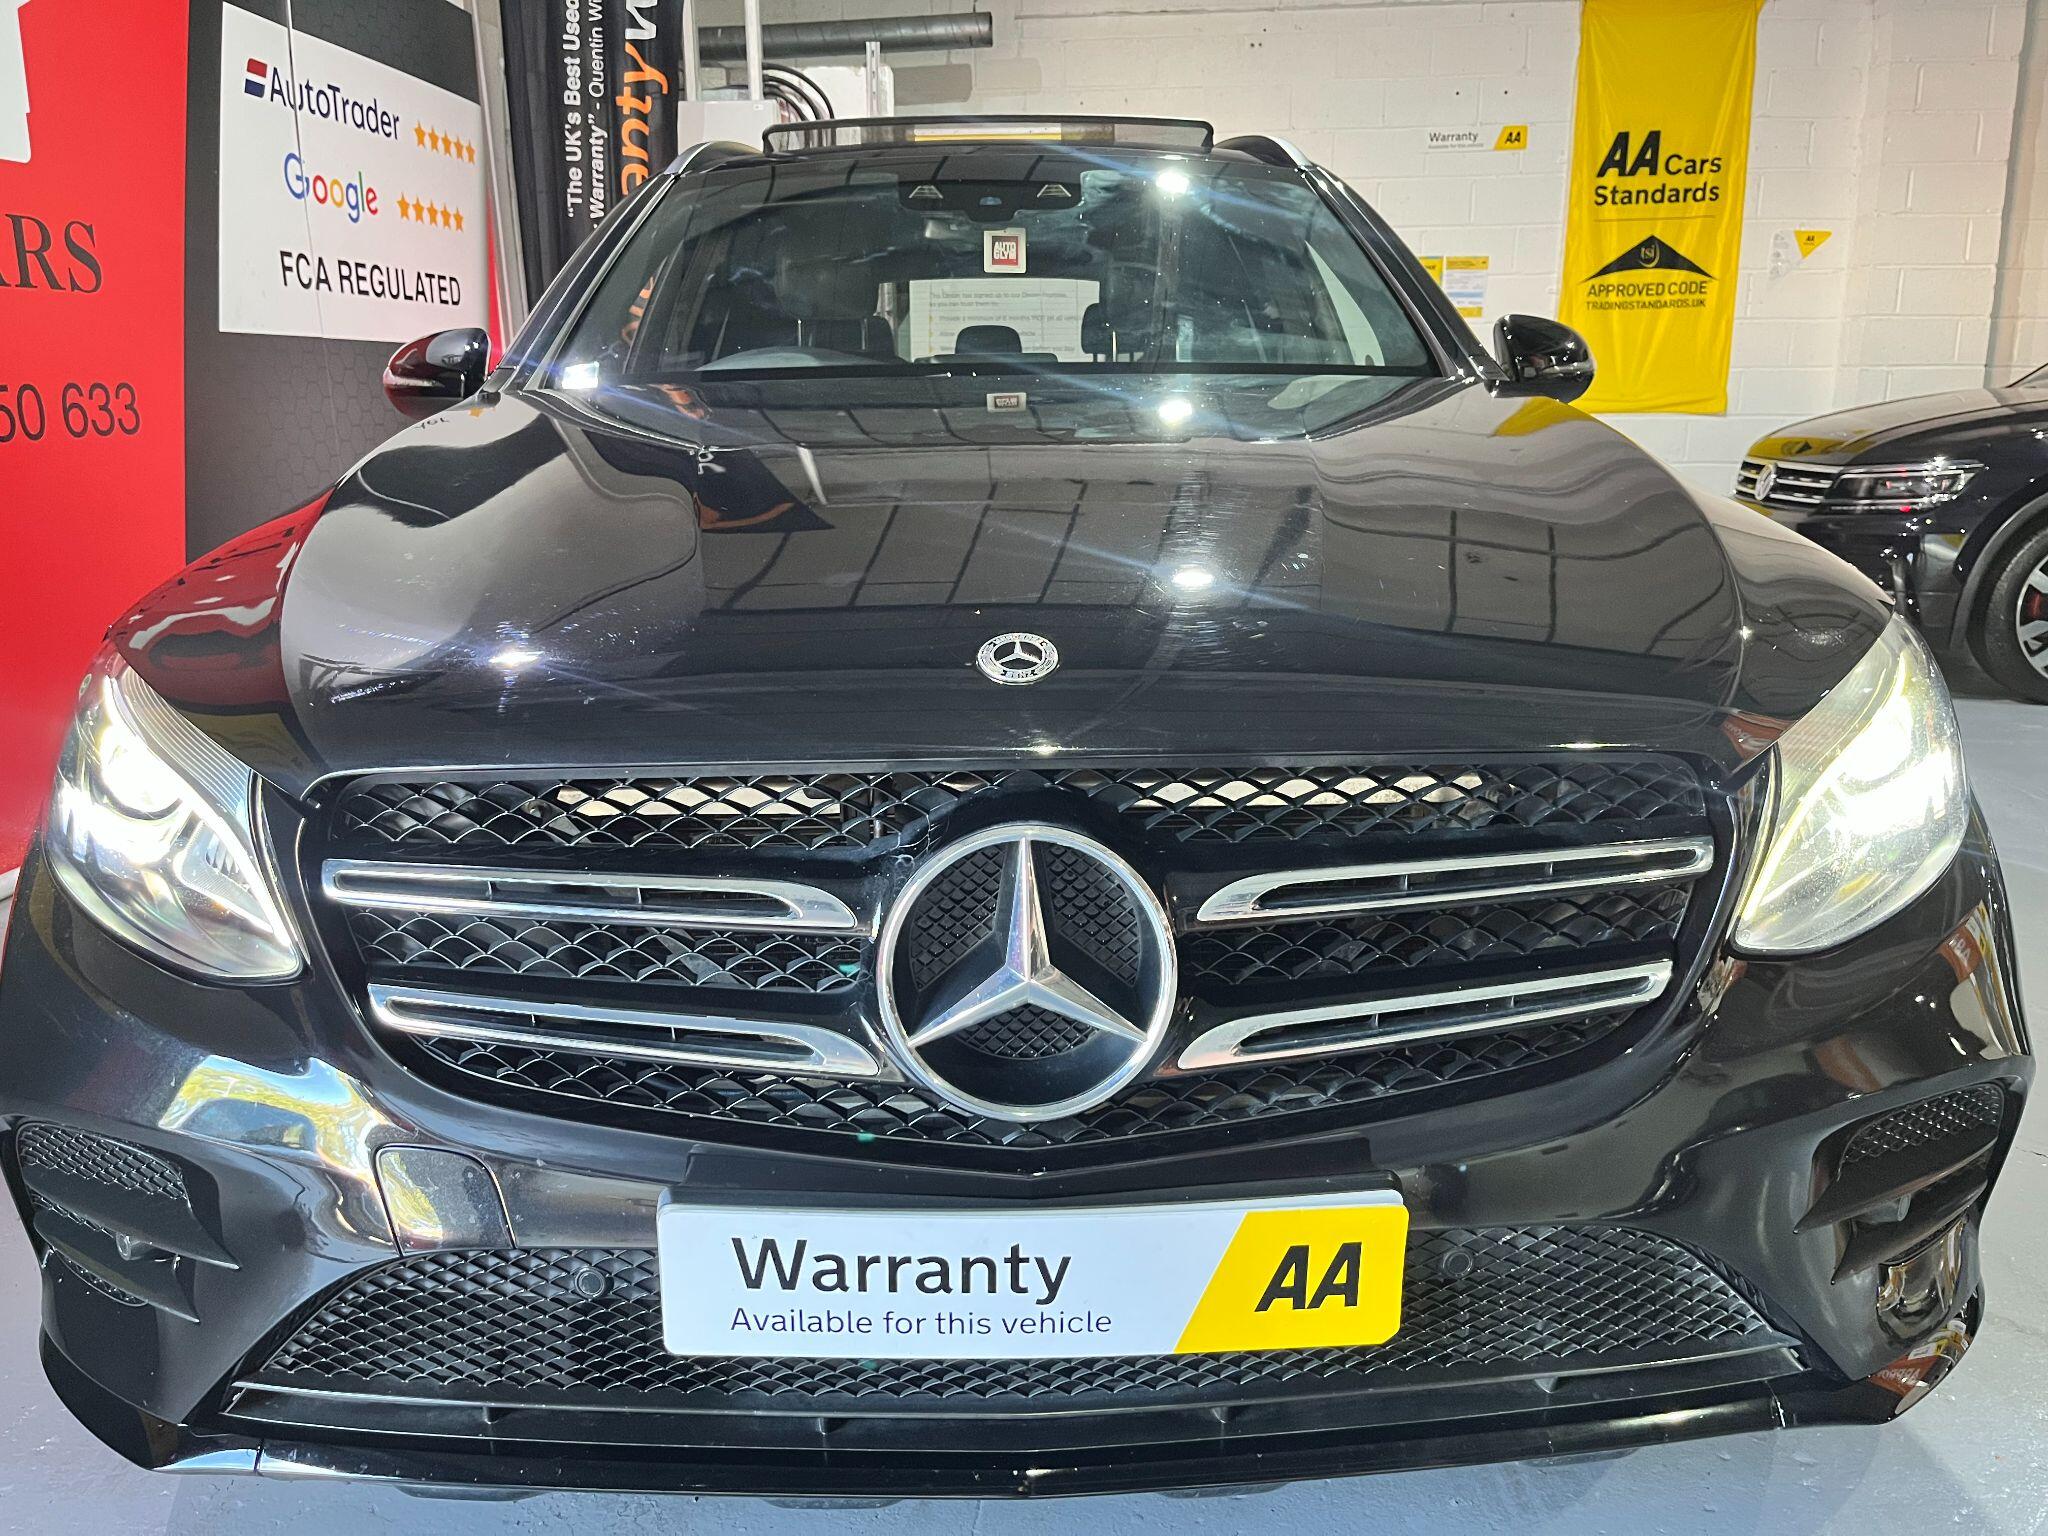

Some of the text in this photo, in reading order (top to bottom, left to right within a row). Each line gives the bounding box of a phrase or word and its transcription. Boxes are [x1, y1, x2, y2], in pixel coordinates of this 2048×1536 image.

[564, 56, 581, 105] Best
[588, 27, 604, 97] Quentin
[270, 66, 400, 140] AutoTrader
[564, 112, 581, 161] UK’s
[1428, 132, 1478, 143] Warranty
[1504, 131, 1521, 144] AA
[1596, 130, 1722, 178] AA Cars
[284, 152, 379, 223] Google
[1594, 181, 1720, 206] Standards
[0, 213, 103, 294] RS
[279, 250, 461, 306] FCA REGULATED
[1587, 280, 1708, 298] APPROVED CODE
[62, 382, 141, 438] 633
[731, 1237, 1072, 1306] Warranty
[1254, 1241, 1363, 1312] AA
[730, 1307, 1112, 1335] Available for this vehicle
